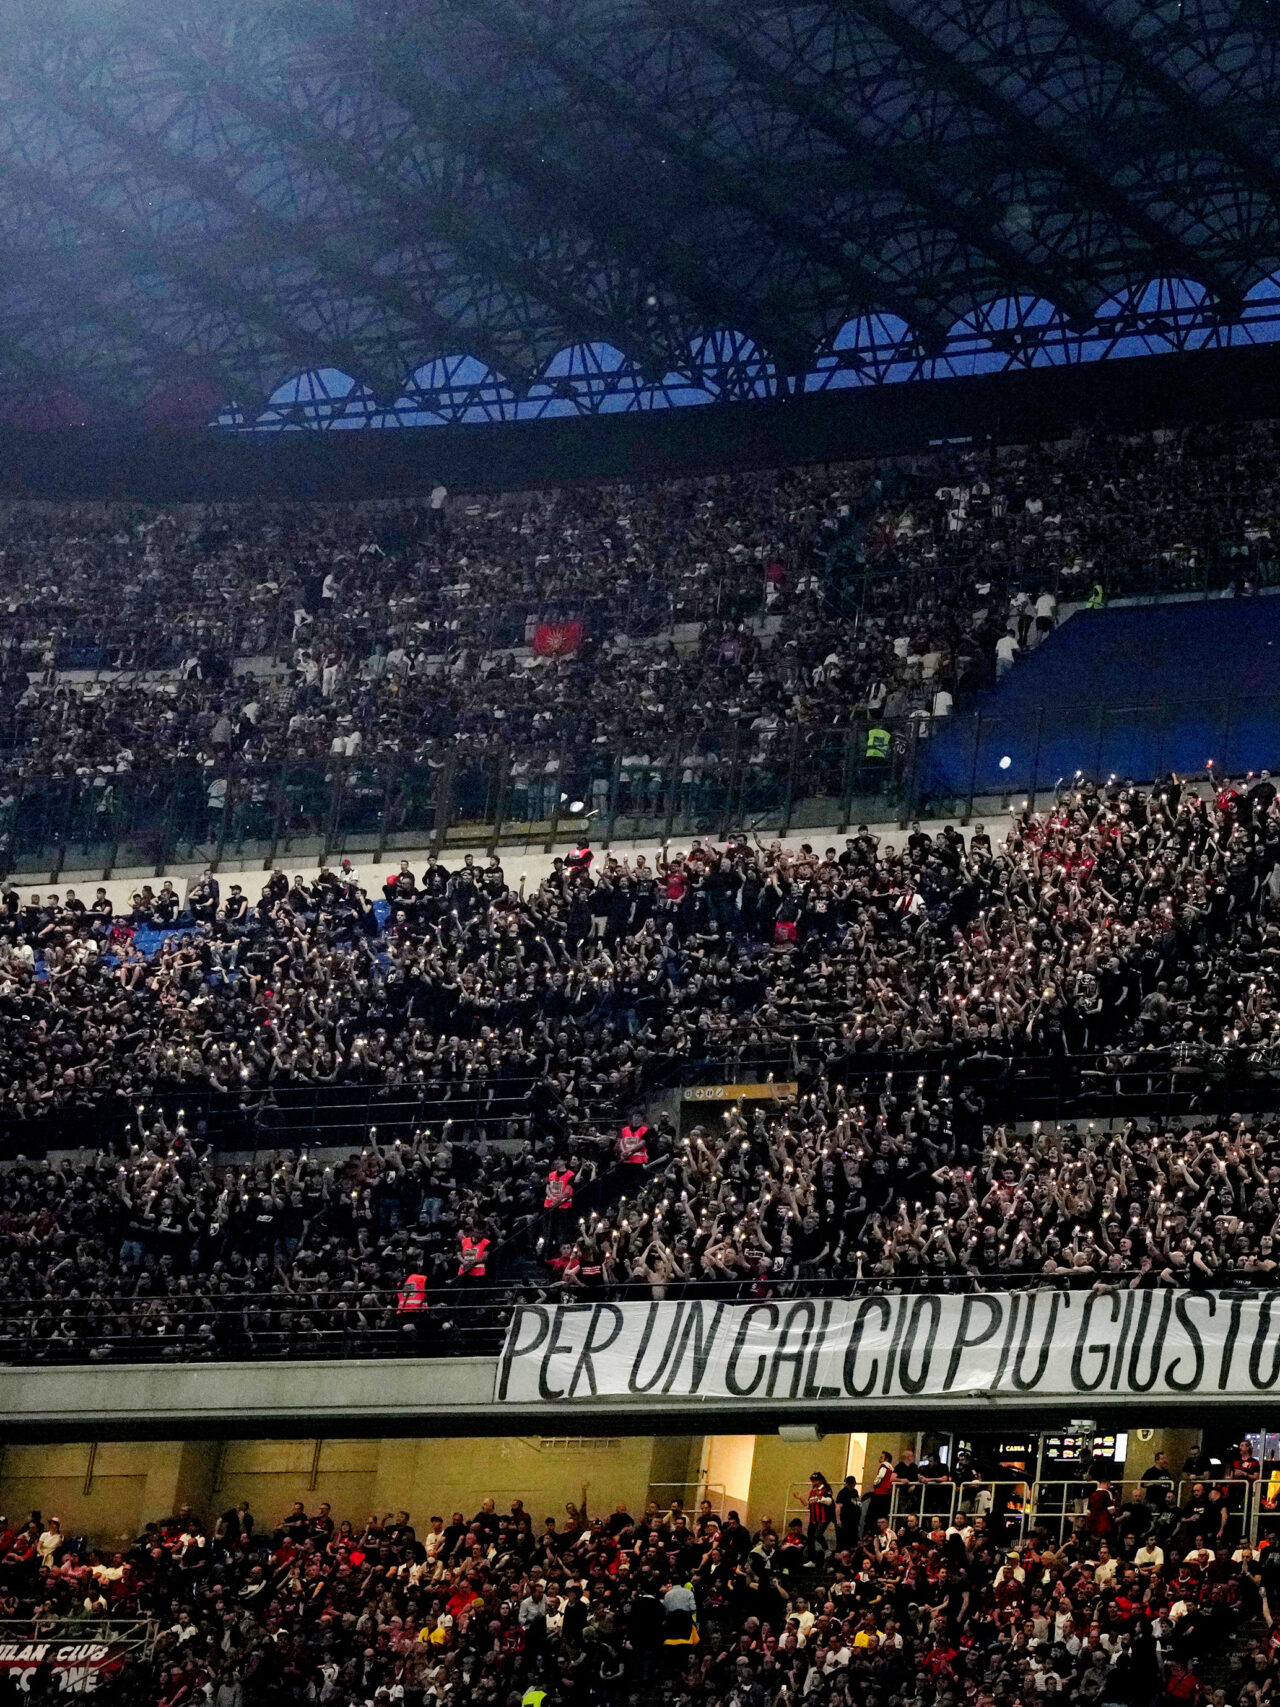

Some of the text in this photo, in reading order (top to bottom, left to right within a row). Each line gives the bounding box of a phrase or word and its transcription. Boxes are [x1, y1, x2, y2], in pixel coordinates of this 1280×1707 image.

[498, 1304, 624, 1401] PER
[628, 1301, 725, 1394] UN
[725, 1296, 942, 1399] CALCIO
[57, 1644, 109, 1661] CLUB
